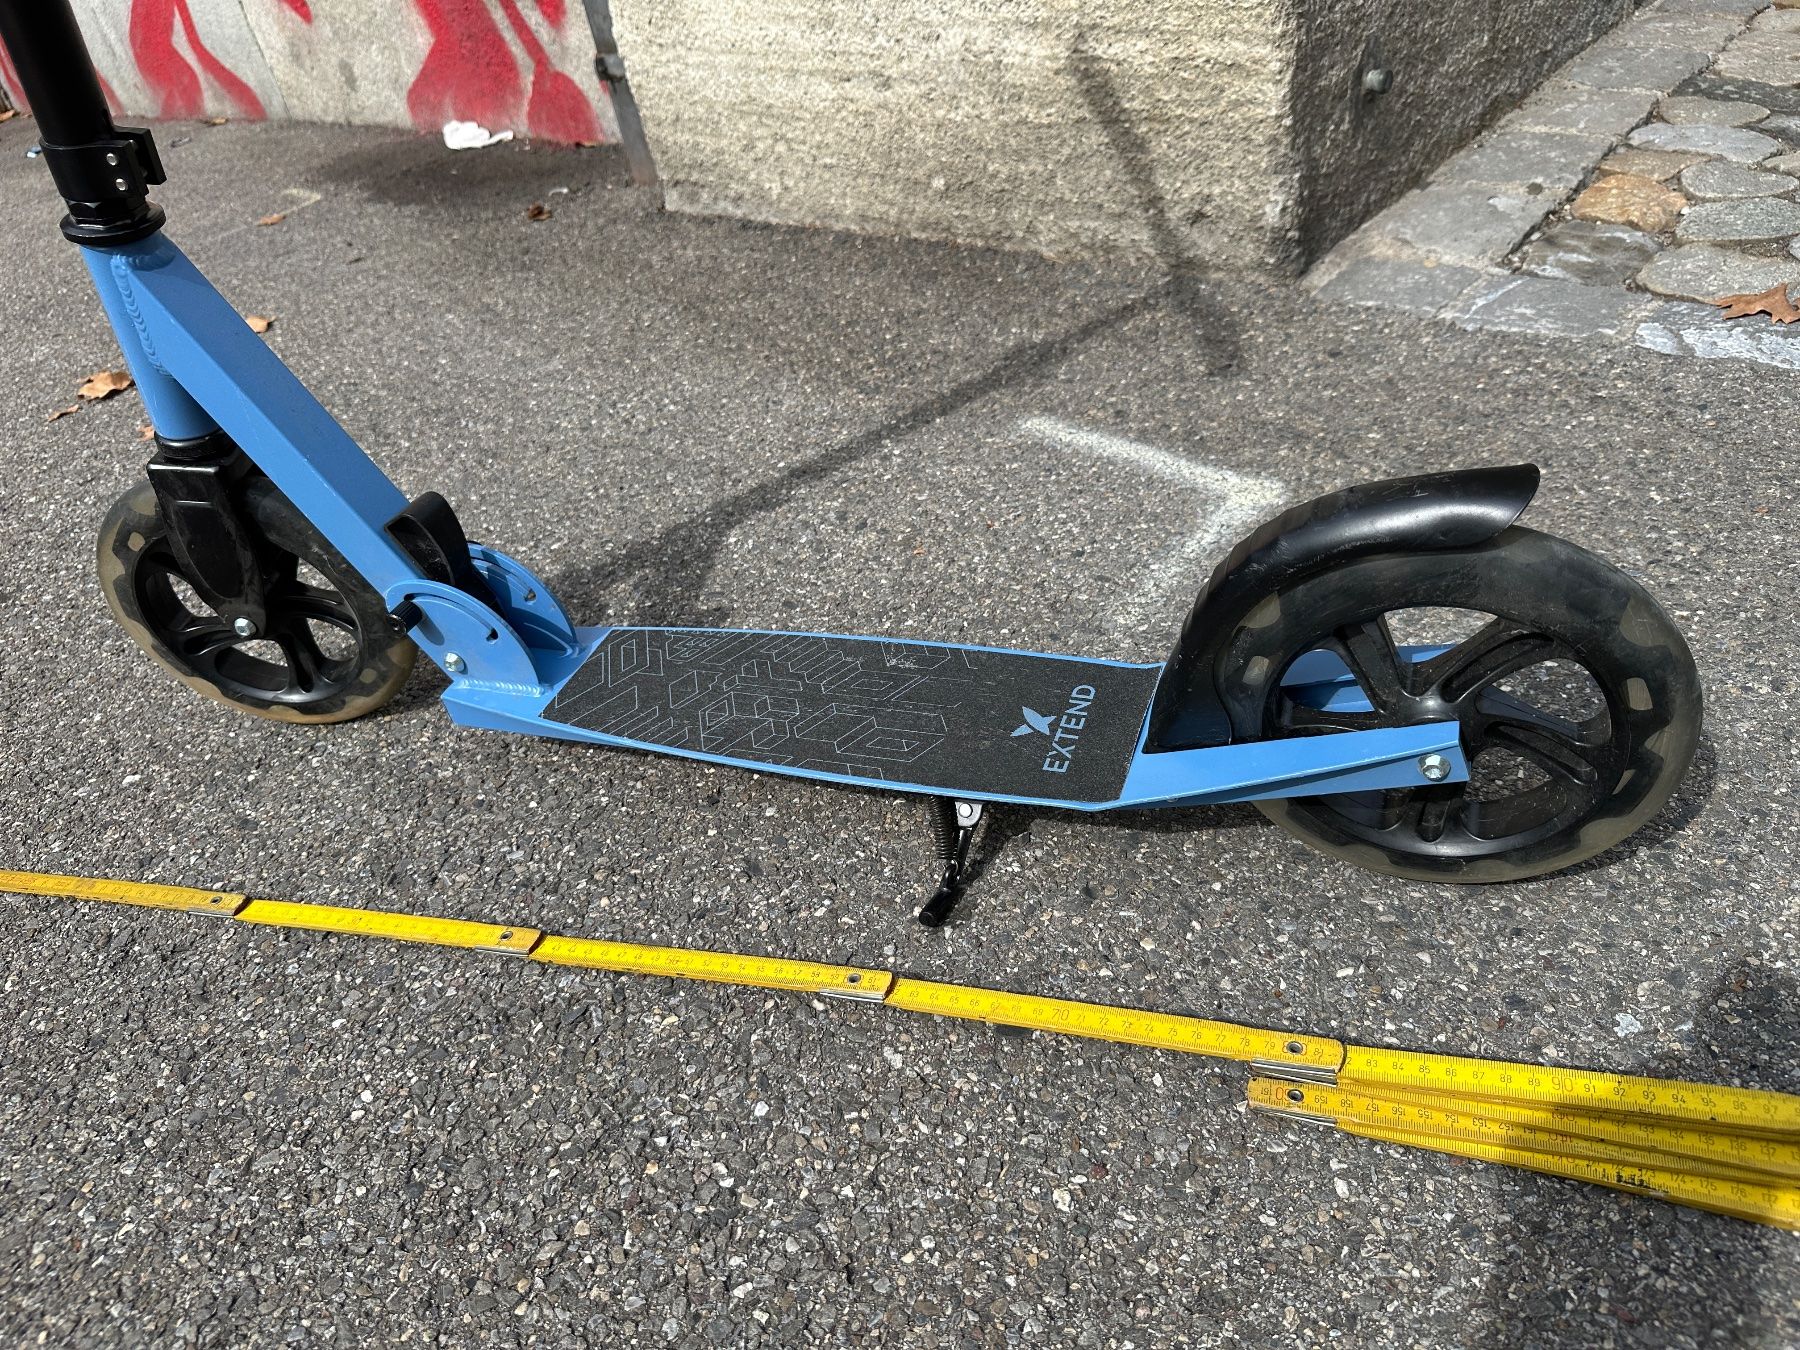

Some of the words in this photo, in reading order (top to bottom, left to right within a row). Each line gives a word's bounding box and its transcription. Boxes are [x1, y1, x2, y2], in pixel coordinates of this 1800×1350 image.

[1042, 685, 1096, 773] EXTEND
[1051, 1007, 1070, 1021] 70
[1167, 1027, 1178, 1037] 75
[1191, 1030, 1202, 1040] 76
[1215, 1034, 1226, 1043] 77
[1240, 1038, 1251, 1047] 78
[1264, 1041, 1276, 1050] 79
[1366, 1058, 1378, 1068] 83
[1392, 1061, 1404, 1071] 84
[1419, 1064, 1431, 1074] 85
[1445, 1067, 1457, 1077] 86
[1472, 1070, 1485, 1080] 87
[1499, 1073, 1512, 1083] 88
[1528, 1076, 1541, 1087] 89
[1551, 1076, 1574, 1092] 90
[1583, 1083, 1596, 1093] 91
[1613, 1086, 1626, 1097] 92
[1642, 1090, 1656, 1101] 93
[1671, 1093, 1686, 1104] 94
[1702, 1097, 1716, 1108] 95
[1732, 1100, 1747, 1111] 96
[1762, 1103, 1778, 1114] 97
[1314, 1095, 1328, 1104] 159
[1340, 1098, 1354, 1109] 158
[1366, 1102, 1380, 1112] 157
[1391, 1106, 1406, 1116] 156
[1418, 1108, 1433, 1120] 155
[1445, 1113, 1460, 1124] 154
[1472, 1116, 1487, 1128] 153
[1669, 1128, 1684, 1140] 134
